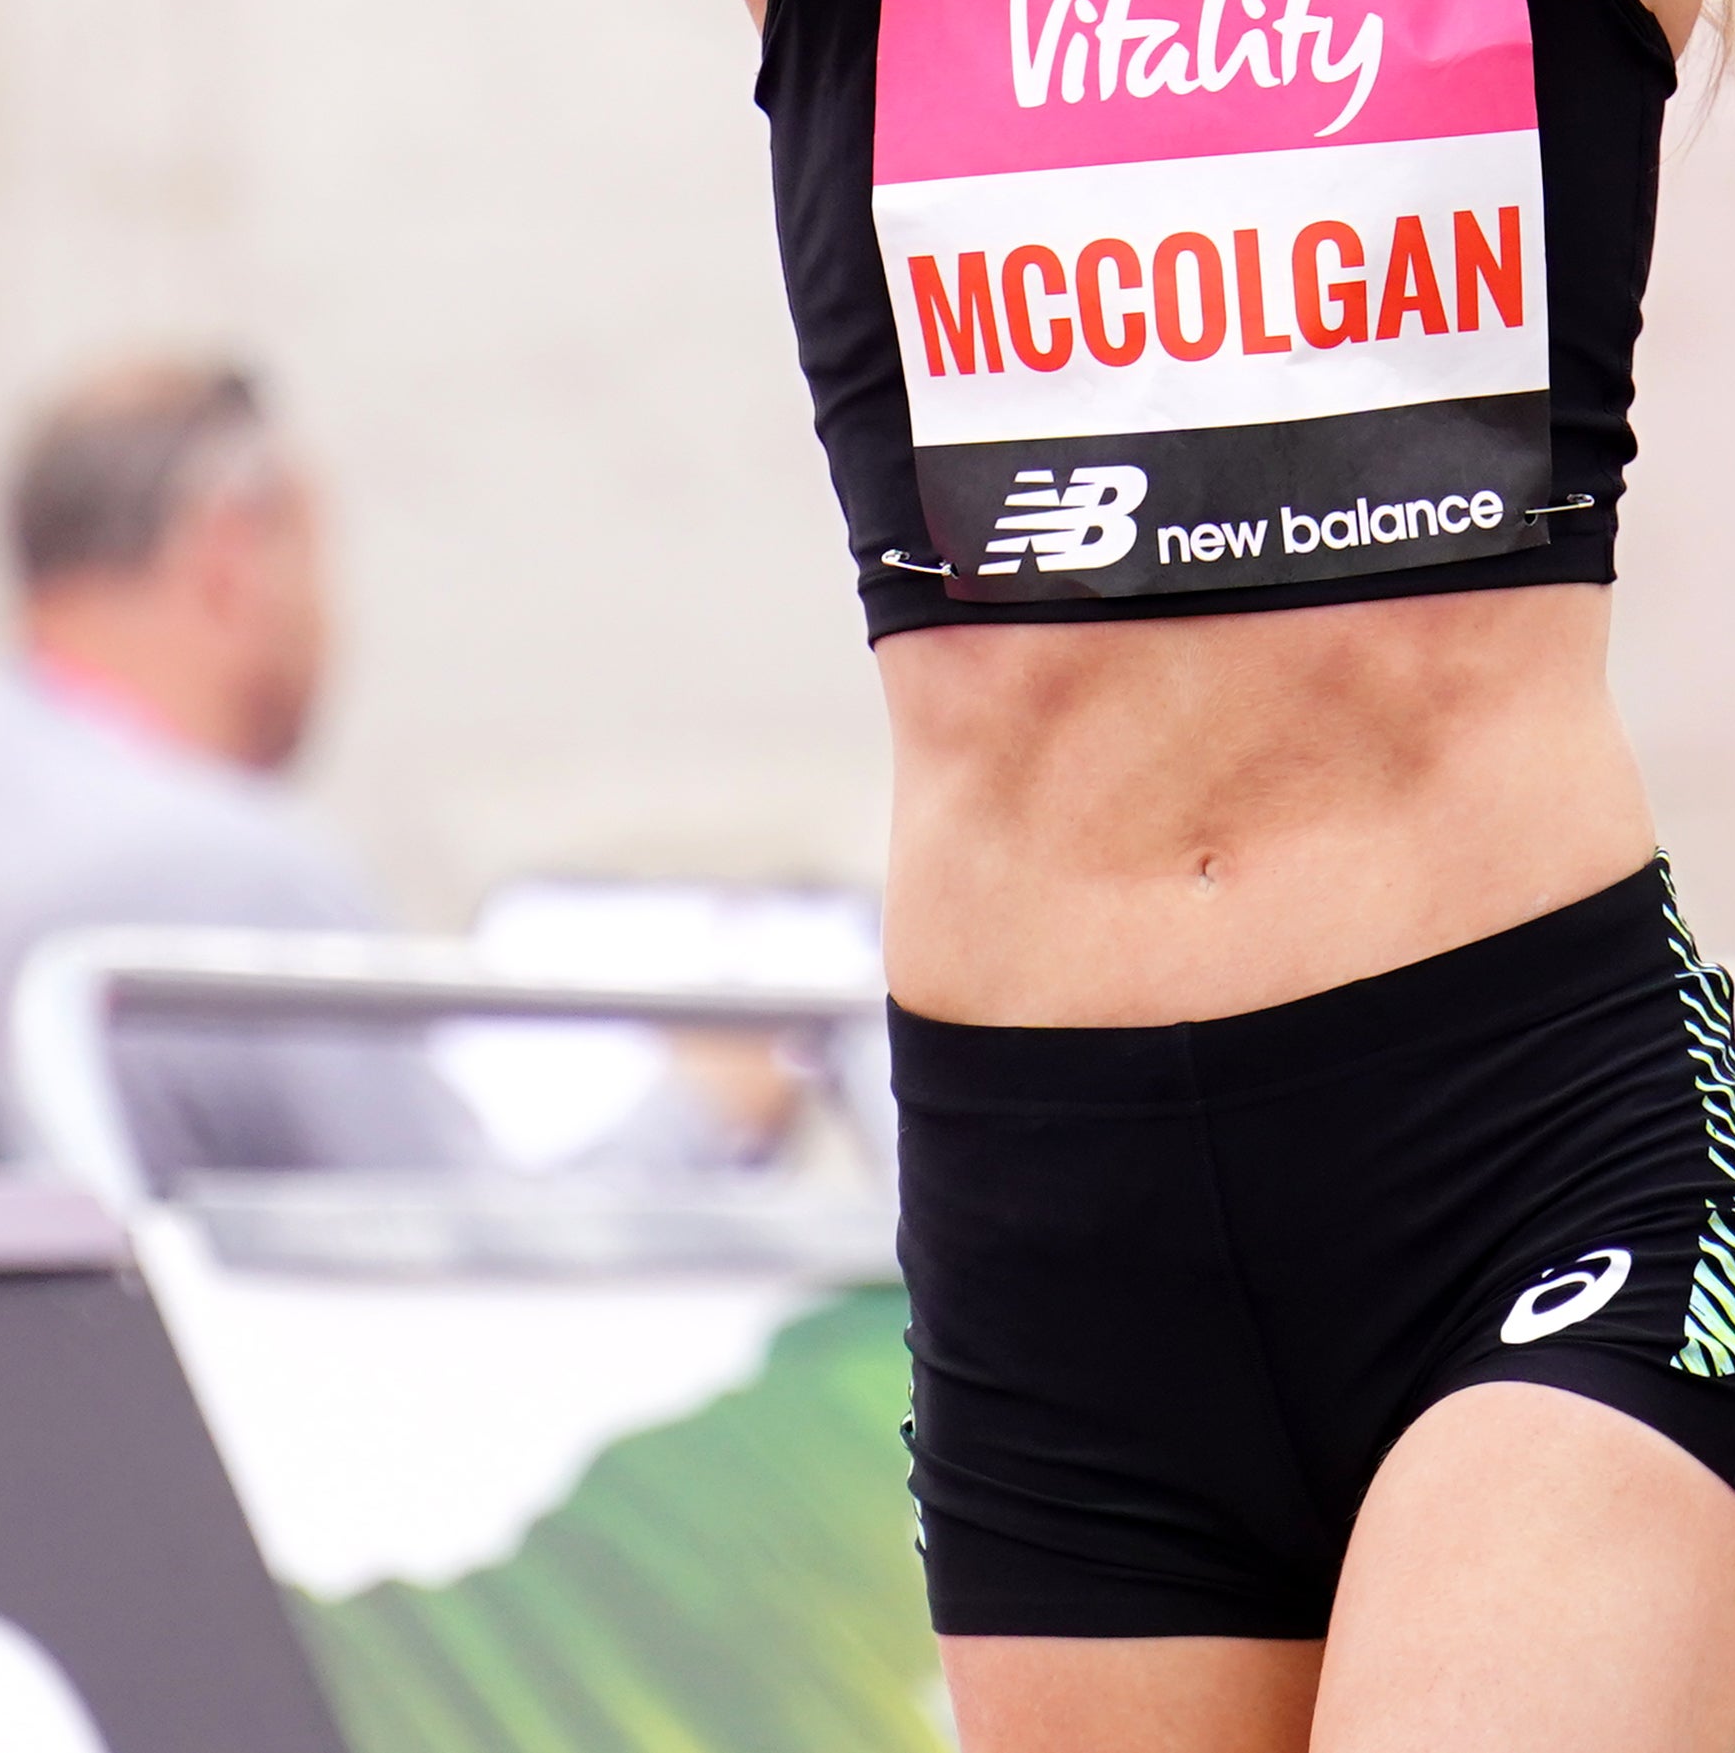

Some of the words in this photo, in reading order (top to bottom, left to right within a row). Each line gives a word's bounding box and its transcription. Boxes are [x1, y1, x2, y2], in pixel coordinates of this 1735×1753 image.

[907, 204, 1525, 379] MCCOLGAN
[977, 464, 1149, 574] NB
[1156, 518, 1269, 566] new
[1280, 489, 1506, 555] balance
